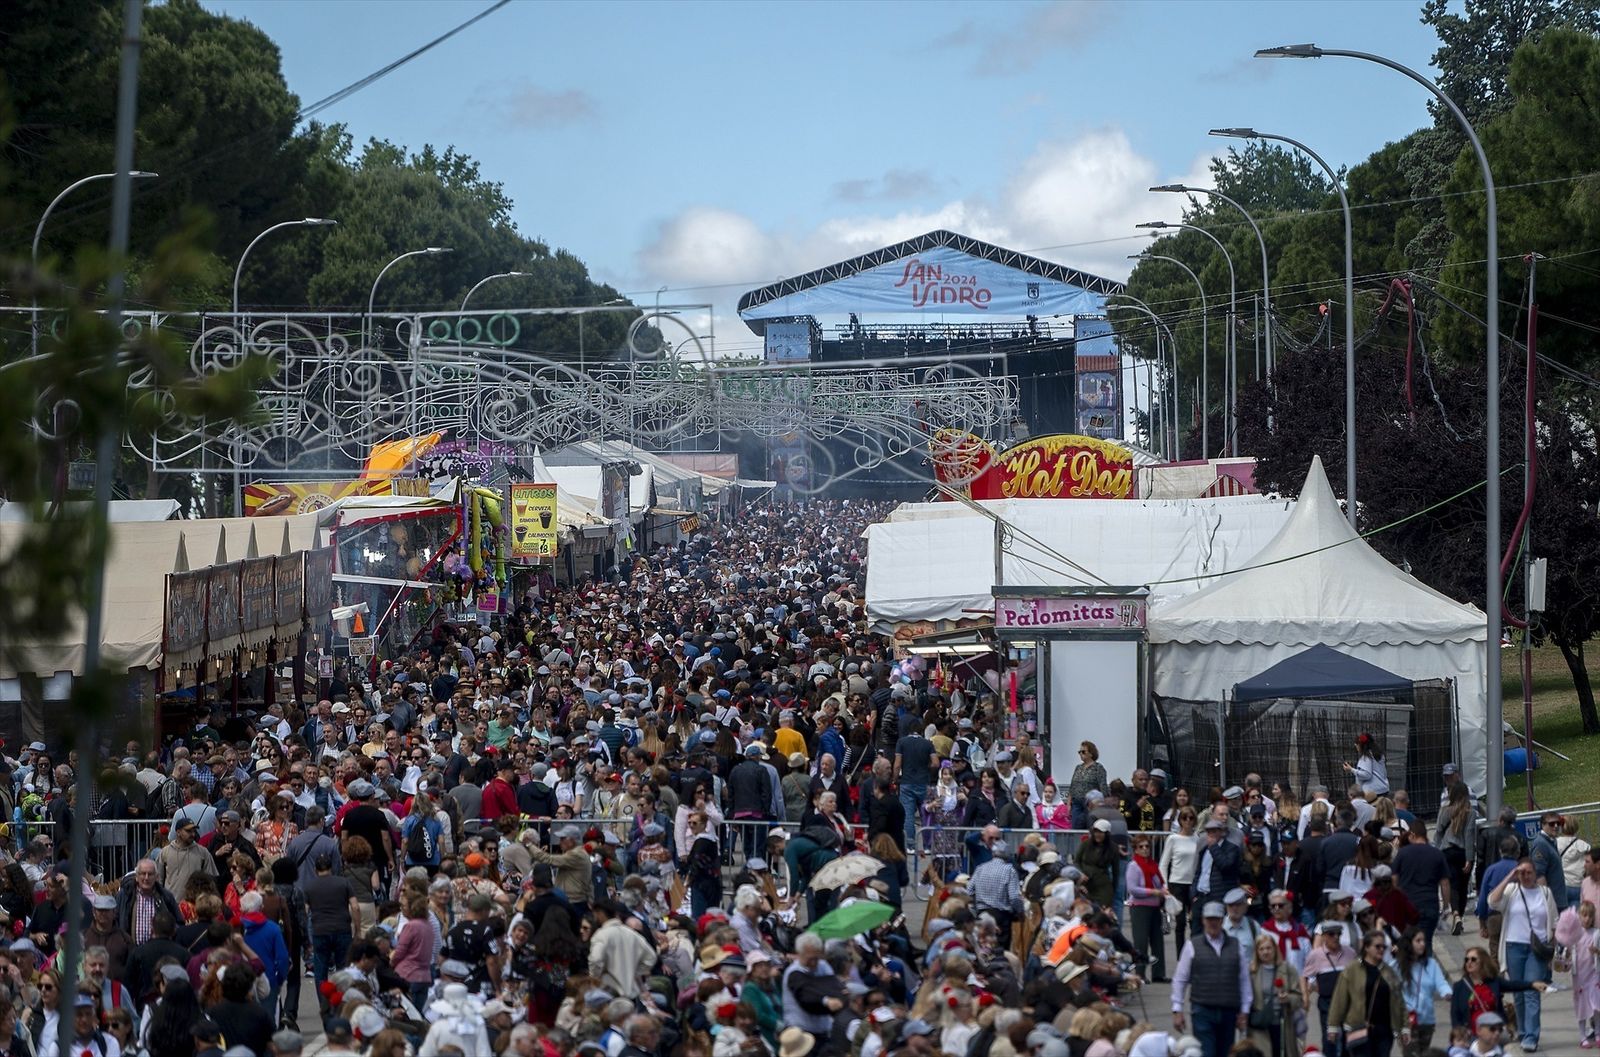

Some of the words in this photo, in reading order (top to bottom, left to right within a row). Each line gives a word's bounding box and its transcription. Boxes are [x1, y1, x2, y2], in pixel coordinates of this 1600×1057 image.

[894, 259, 942, 288] SAN
[943, 275, 977, 287] 2024
[912, 281, 992, 309] ISIDRO
[1002, 450, 1067, 498] Hot
[1070, 451, 1132, 499] Dog
[513, 488, 555, 499] LITROS
[1004, 603, 1115, 626] Palomitas
